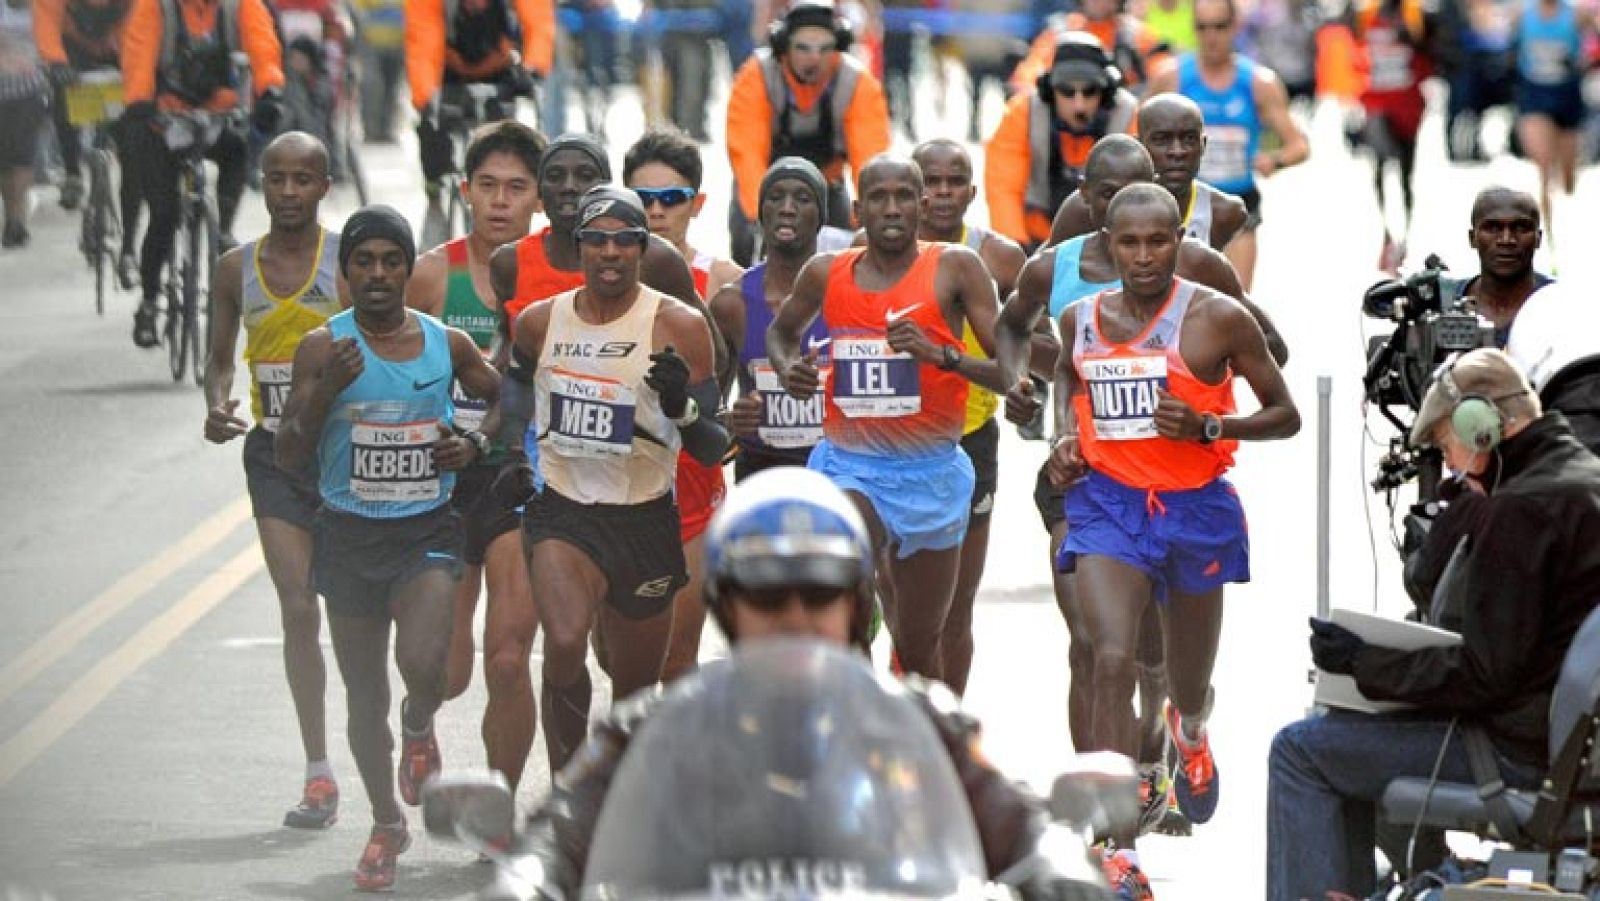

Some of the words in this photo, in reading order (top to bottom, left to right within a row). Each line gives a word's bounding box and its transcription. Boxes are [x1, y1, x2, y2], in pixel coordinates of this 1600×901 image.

[552, 343, 593, 357] NYAC
[849, 344, 879, 356] ING
[272, 368, 291, 380] IN
[1096, 364, 1126, 377] ING
[851, 362, 896, 395] LEL
[566, 382, 597, 397] ING
[767, 393, 826, 426] KORI
[560, 399, 614, 439] MEB
[374, 431, 405, 443] ING
[354, 447, 436, 479] KEBEDE
[708, 858, 867, 899] POLICE
